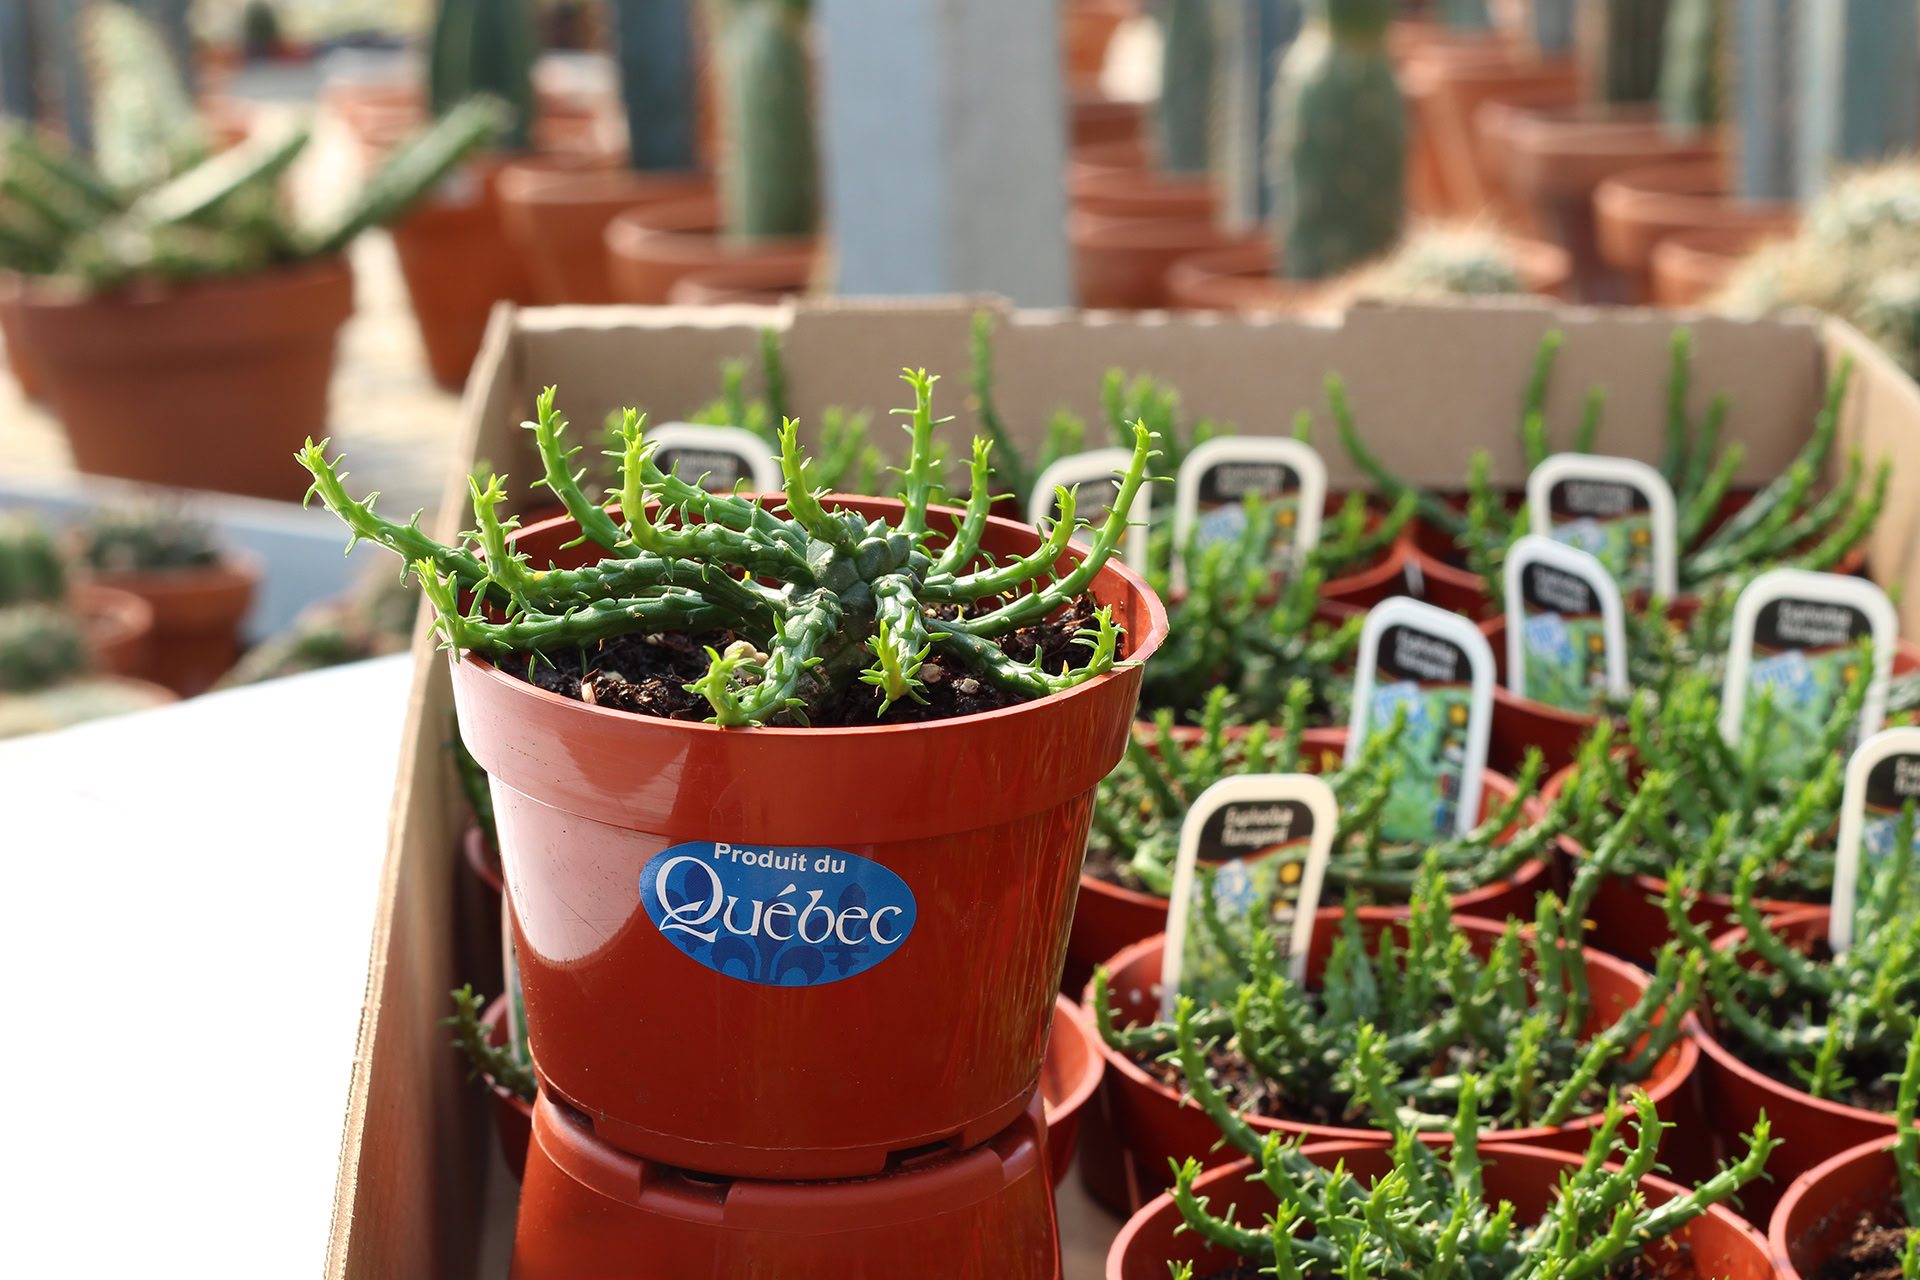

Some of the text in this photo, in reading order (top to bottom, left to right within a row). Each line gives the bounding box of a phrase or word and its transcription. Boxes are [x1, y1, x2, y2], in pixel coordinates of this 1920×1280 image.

[714, 842, 846, 874] Produit du
[656, 855, 902, 945] Québec
